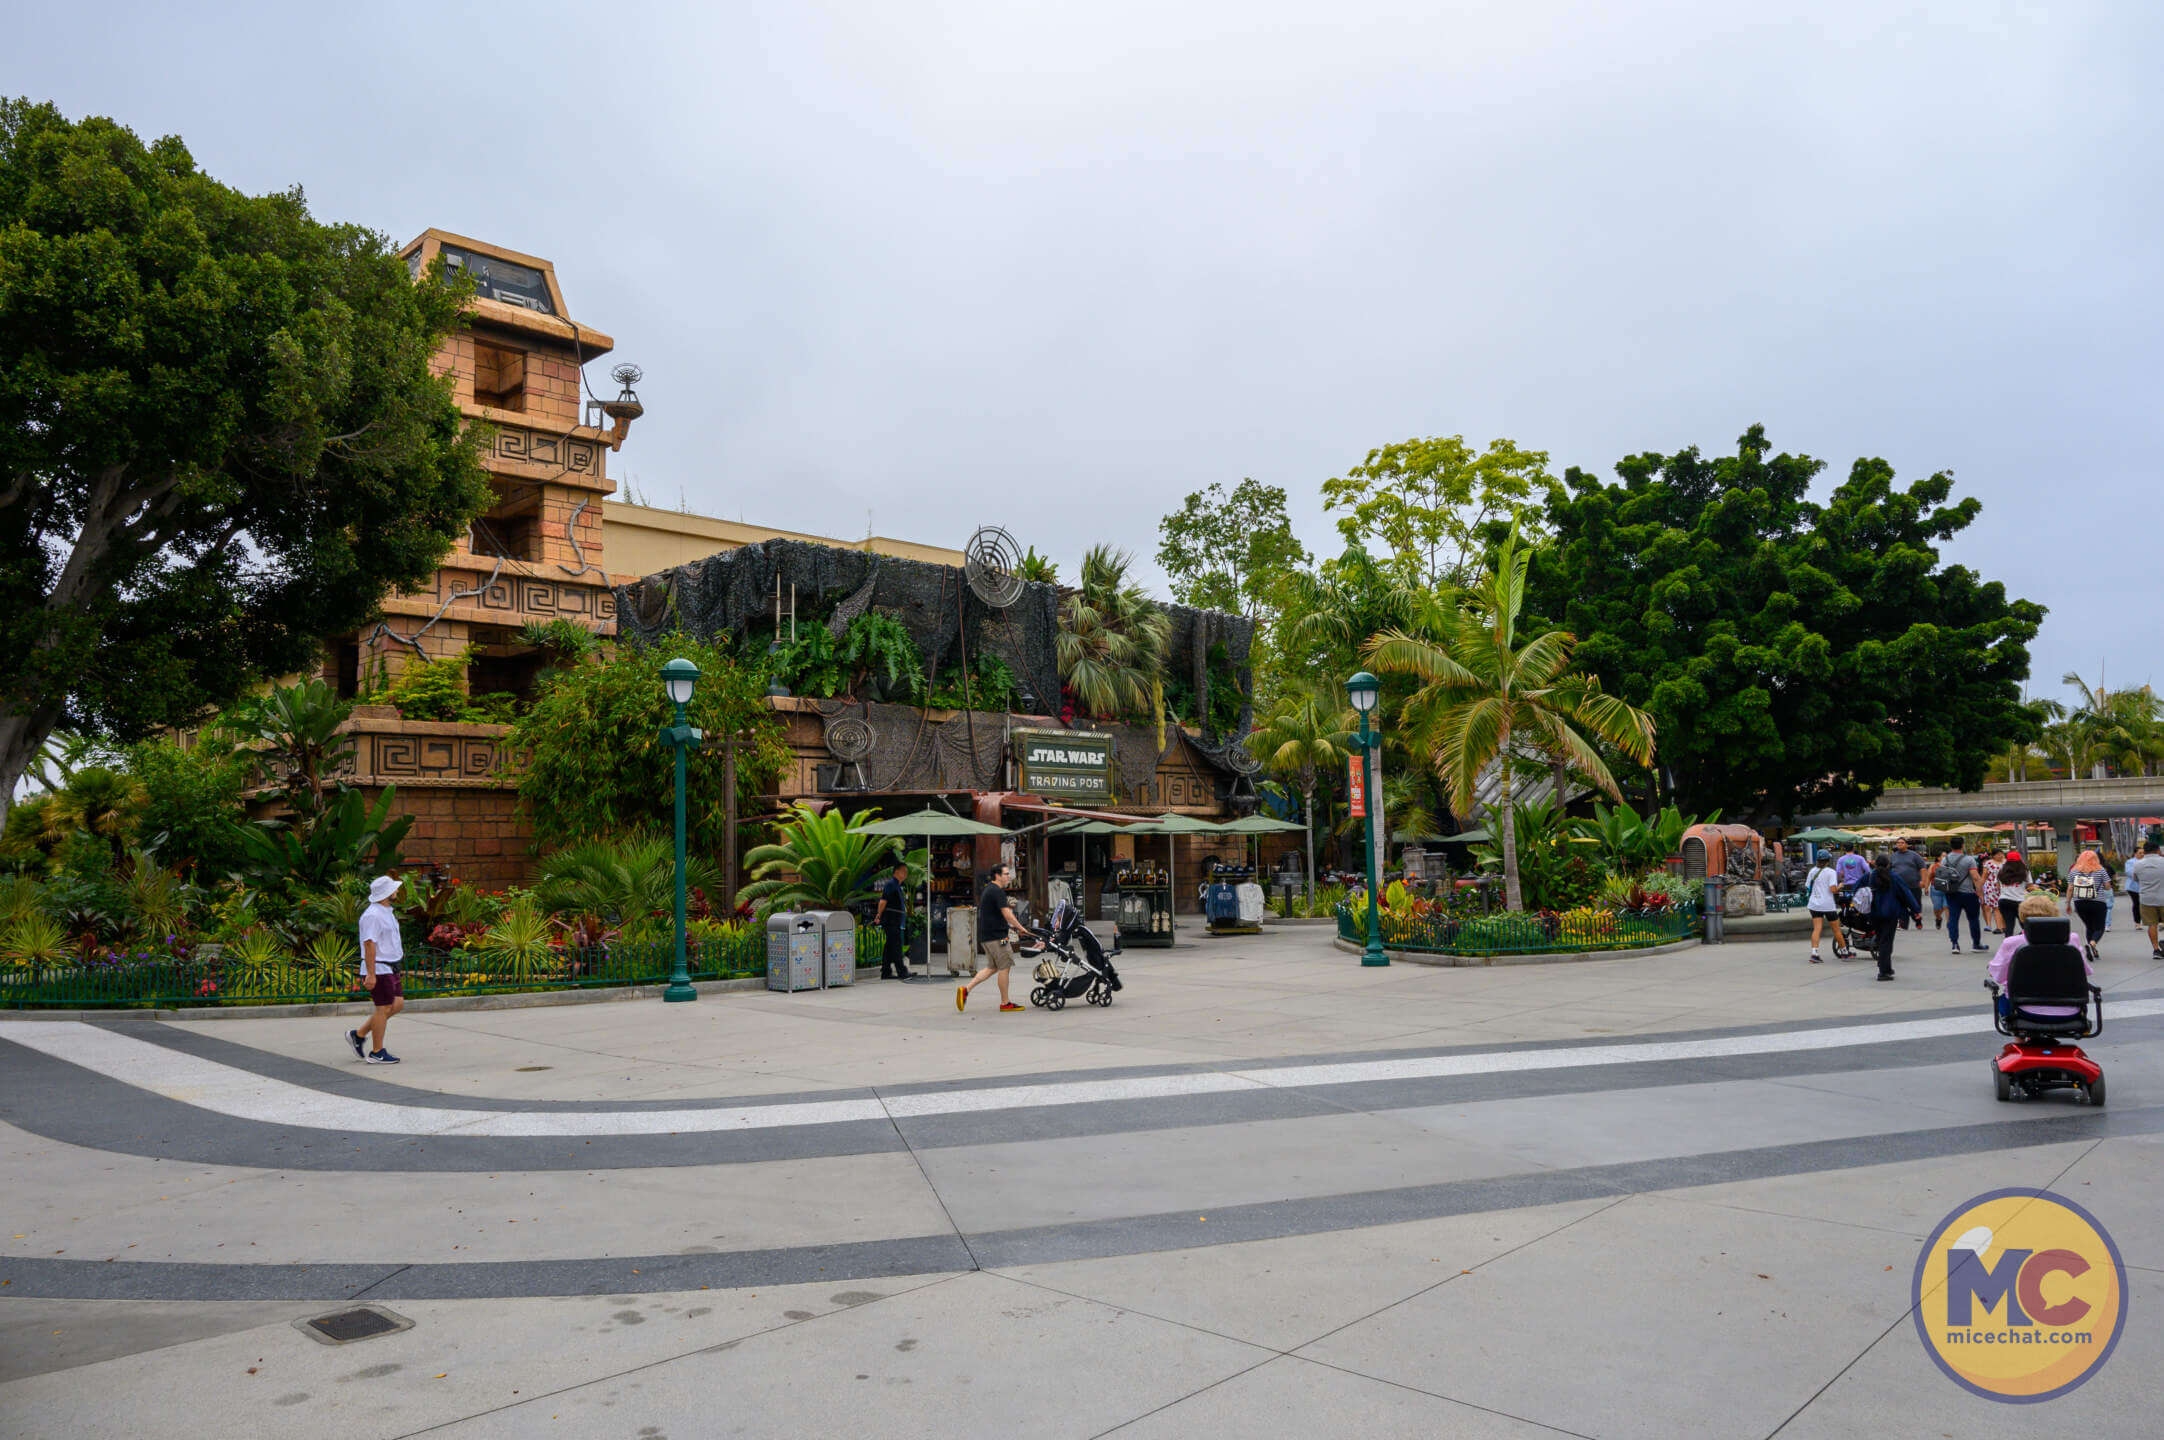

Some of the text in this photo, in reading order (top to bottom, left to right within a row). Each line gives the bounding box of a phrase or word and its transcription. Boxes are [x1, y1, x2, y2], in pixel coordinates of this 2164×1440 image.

[1028, 749, 1105, 764] STAR WARS
[1030, 776, 1104, 788] TRADING POST
